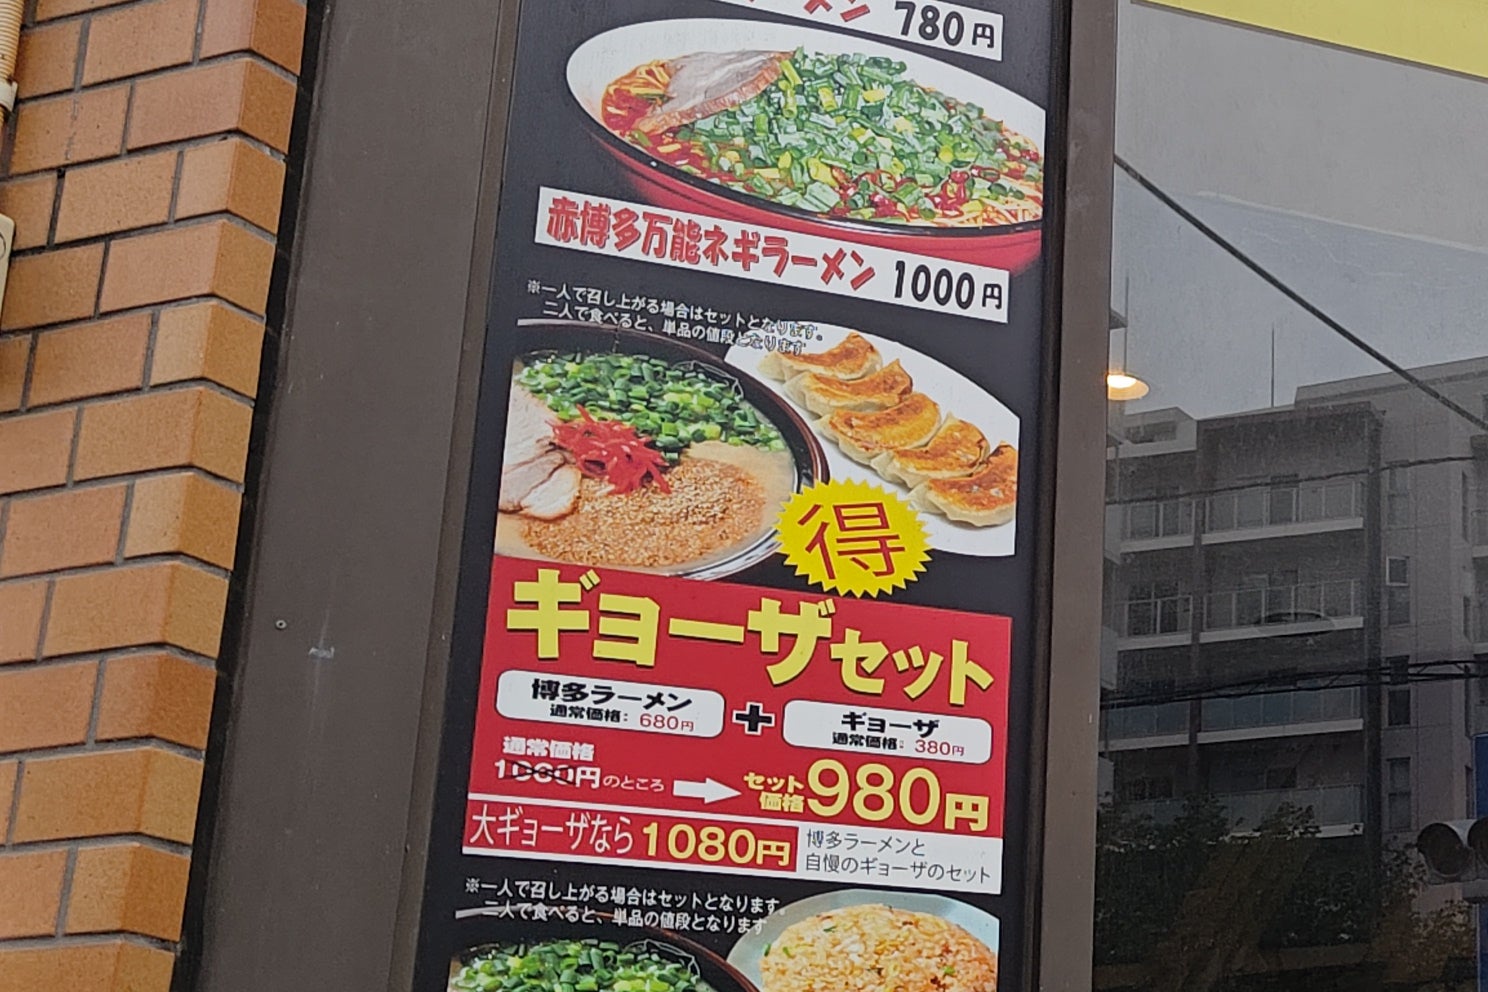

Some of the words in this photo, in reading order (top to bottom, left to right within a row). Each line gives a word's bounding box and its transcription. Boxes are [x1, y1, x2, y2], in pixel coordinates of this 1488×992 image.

[895, 0, 995, 48] 780円
[545, 195, 876, 291] 赤博多万能ネギラーメン
[894, 259, 1004, 311] 1000円
[798, 502, 905, 580] 得
[506, 568, 995, 706] ギョーザセット
[530, 678, 693, 712] 博多ラーメン
[841, 712, 940, 738] ギョーザ
[503, 736, 595, 762] 通常価格
[743, 772, 805, 794] セット
[807, 758, 990, 833] 980円
[806, 828, 926, 858] 博多ラーメンと
[805, 853, 991, 884] 自慢のギョーザのセット
